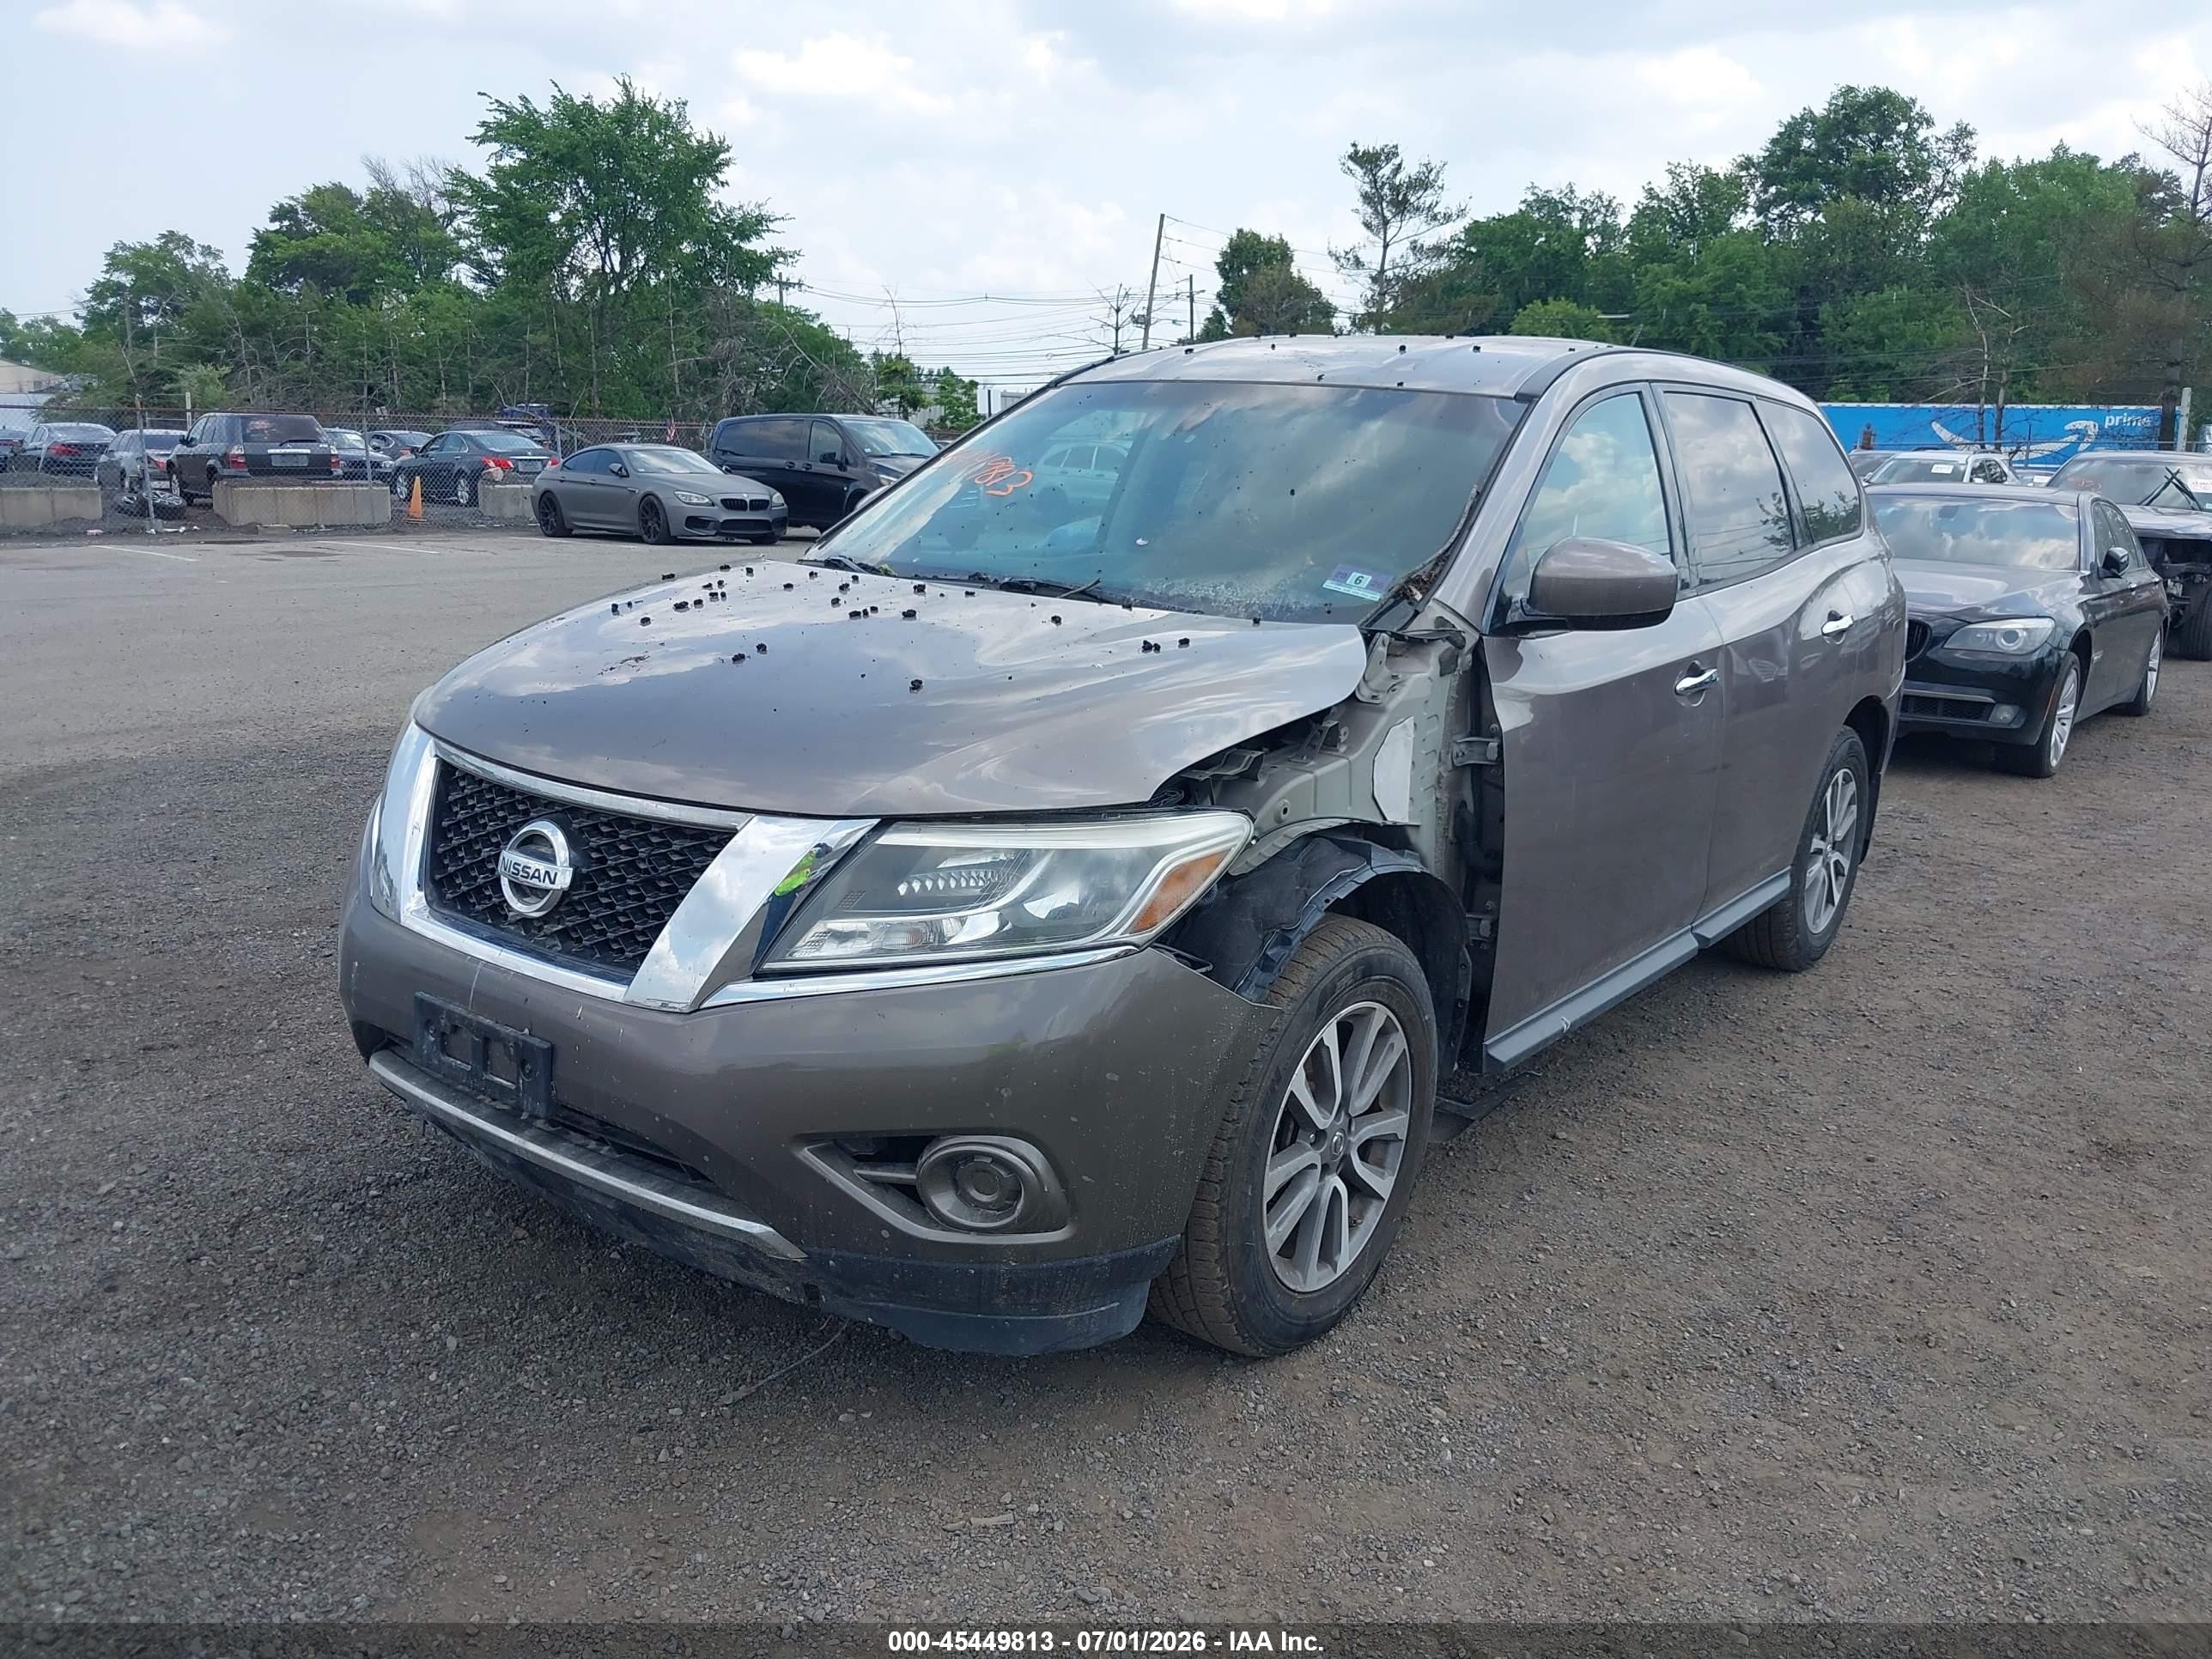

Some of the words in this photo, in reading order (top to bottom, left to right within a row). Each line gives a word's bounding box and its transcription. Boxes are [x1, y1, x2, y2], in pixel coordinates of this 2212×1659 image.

[2105, 412, 2150, 428] prime
[1353, 575, 1364, 586] 6
[500, 856, 558, 885] NISSAN
